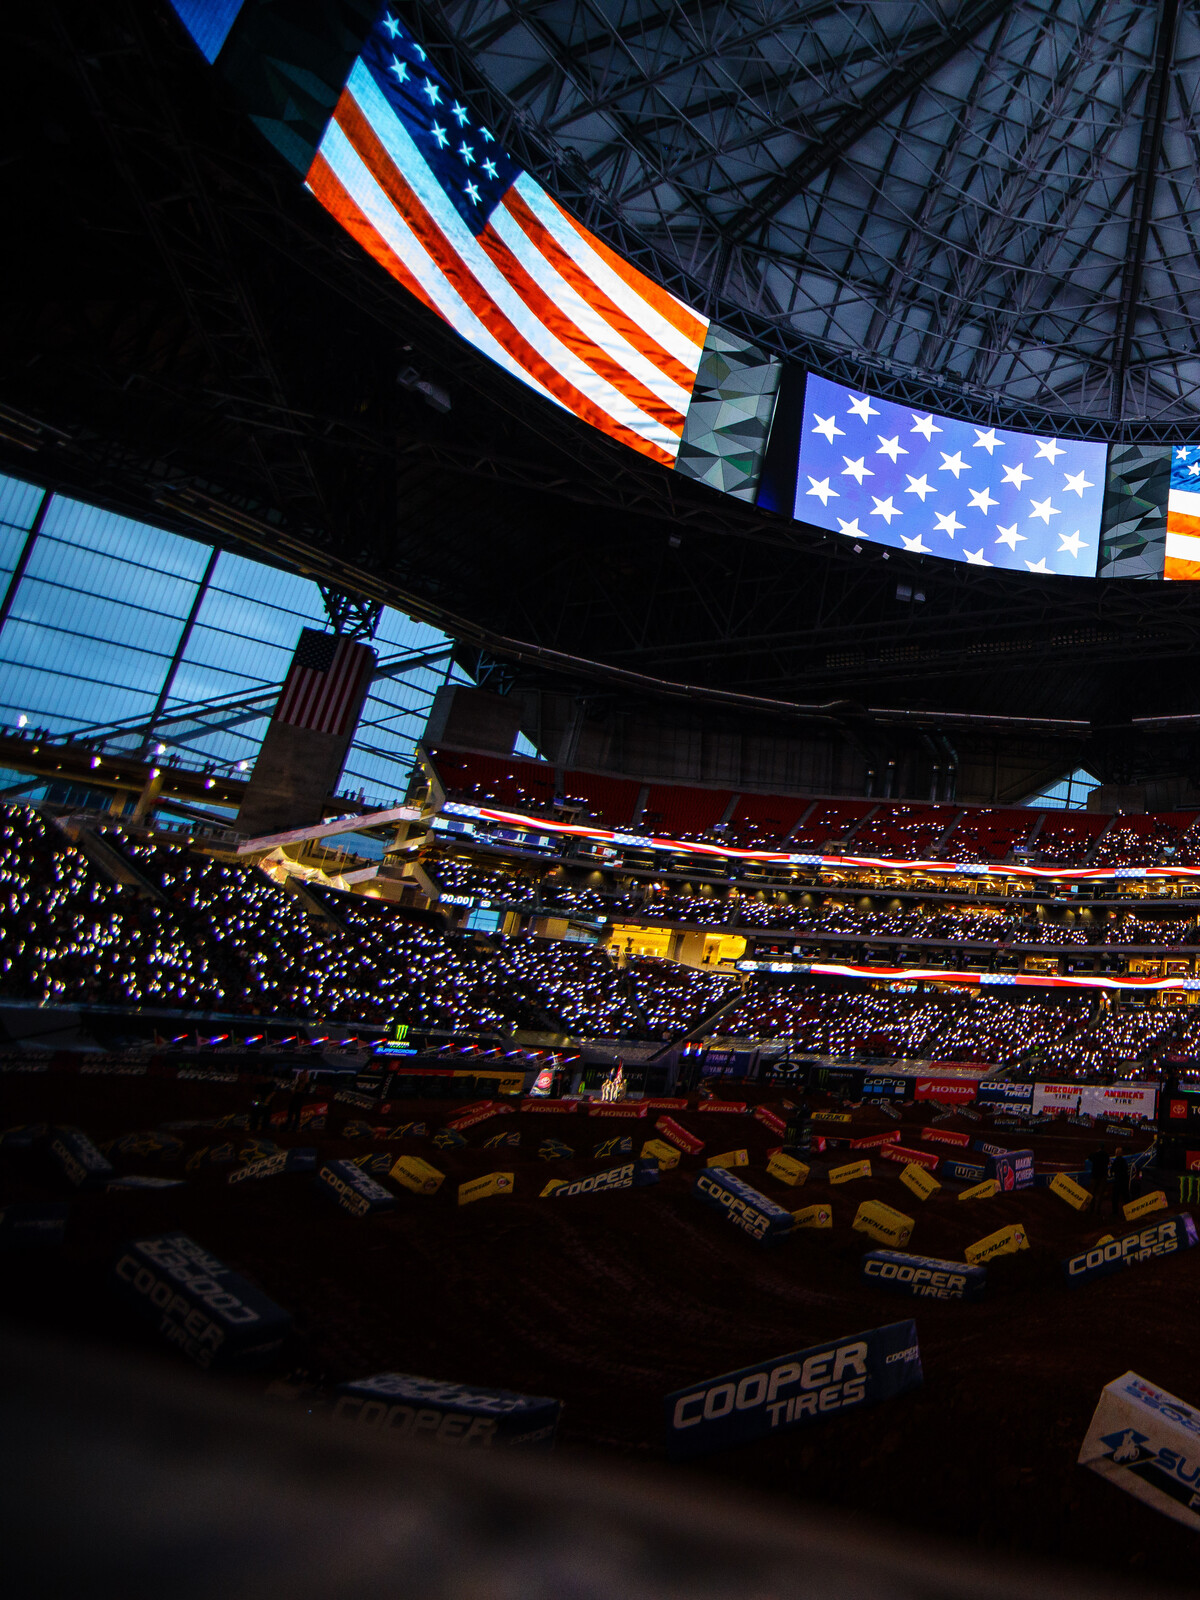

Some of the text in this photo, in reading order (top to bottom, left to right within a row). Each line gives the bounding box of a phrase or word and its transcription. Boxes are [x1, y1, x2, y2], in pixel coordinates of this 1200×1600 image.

[765, 1071, 805, 1080] OAKLEY
[863, 1077, 906, 1087] GoPro
[930, 1085, 976, 1095] HONDA
[979, 1081, 1033, 1092] COOPER
[1004, 1089, 1031, 1098] TIRES
[1044, 1084, 1083, 1094] DISCOUNT
[1104, 1089, 1144, 1099] AMERICA'S
[531, 1105, 566, 1114] HONDA
[600, 1110, 638, 1119] HONDA
[708, 1105, 739, 1113] HONDA
[814, 1112, 845, 1121] SUZUKI
[662, 1126, 693, 1153] HONDA
[931, 1134, 964, 1146] HONDA
[228, 1150, 288, 1185] COOPER
[774, 1162, 798, 1177] DUNLOP
[835, 1167, 860, 1180] DUNLOP
[319, 1165, 371, 1215] COOPER
[556, 1163, 635, 1197] COOPER
[907, 1173, 930, 1194] DUNLOP
[1058, 1181, 1084, 1202] DUNLOP
[697, 1175, 771, 1233] COOPER
[1128, 1196, 1159, 1220] DUNLOP
[726, 1210, 765, 1241] TIRES
[861, 1215, 897, 1237] DUNLOP
[976, 1236, 1011, 1261] DUNLOP
[1068, 1222, 1177, 1276] COOPER
[864, 1260, 967, 1290] COOPER
[115, 1254, 226, 1352] COOPER
[672, 1341, 870, 1430] COOPER
[766, 1377, 866, 1429] TIRES
[333, 1395, 500, 1449] COOPER
